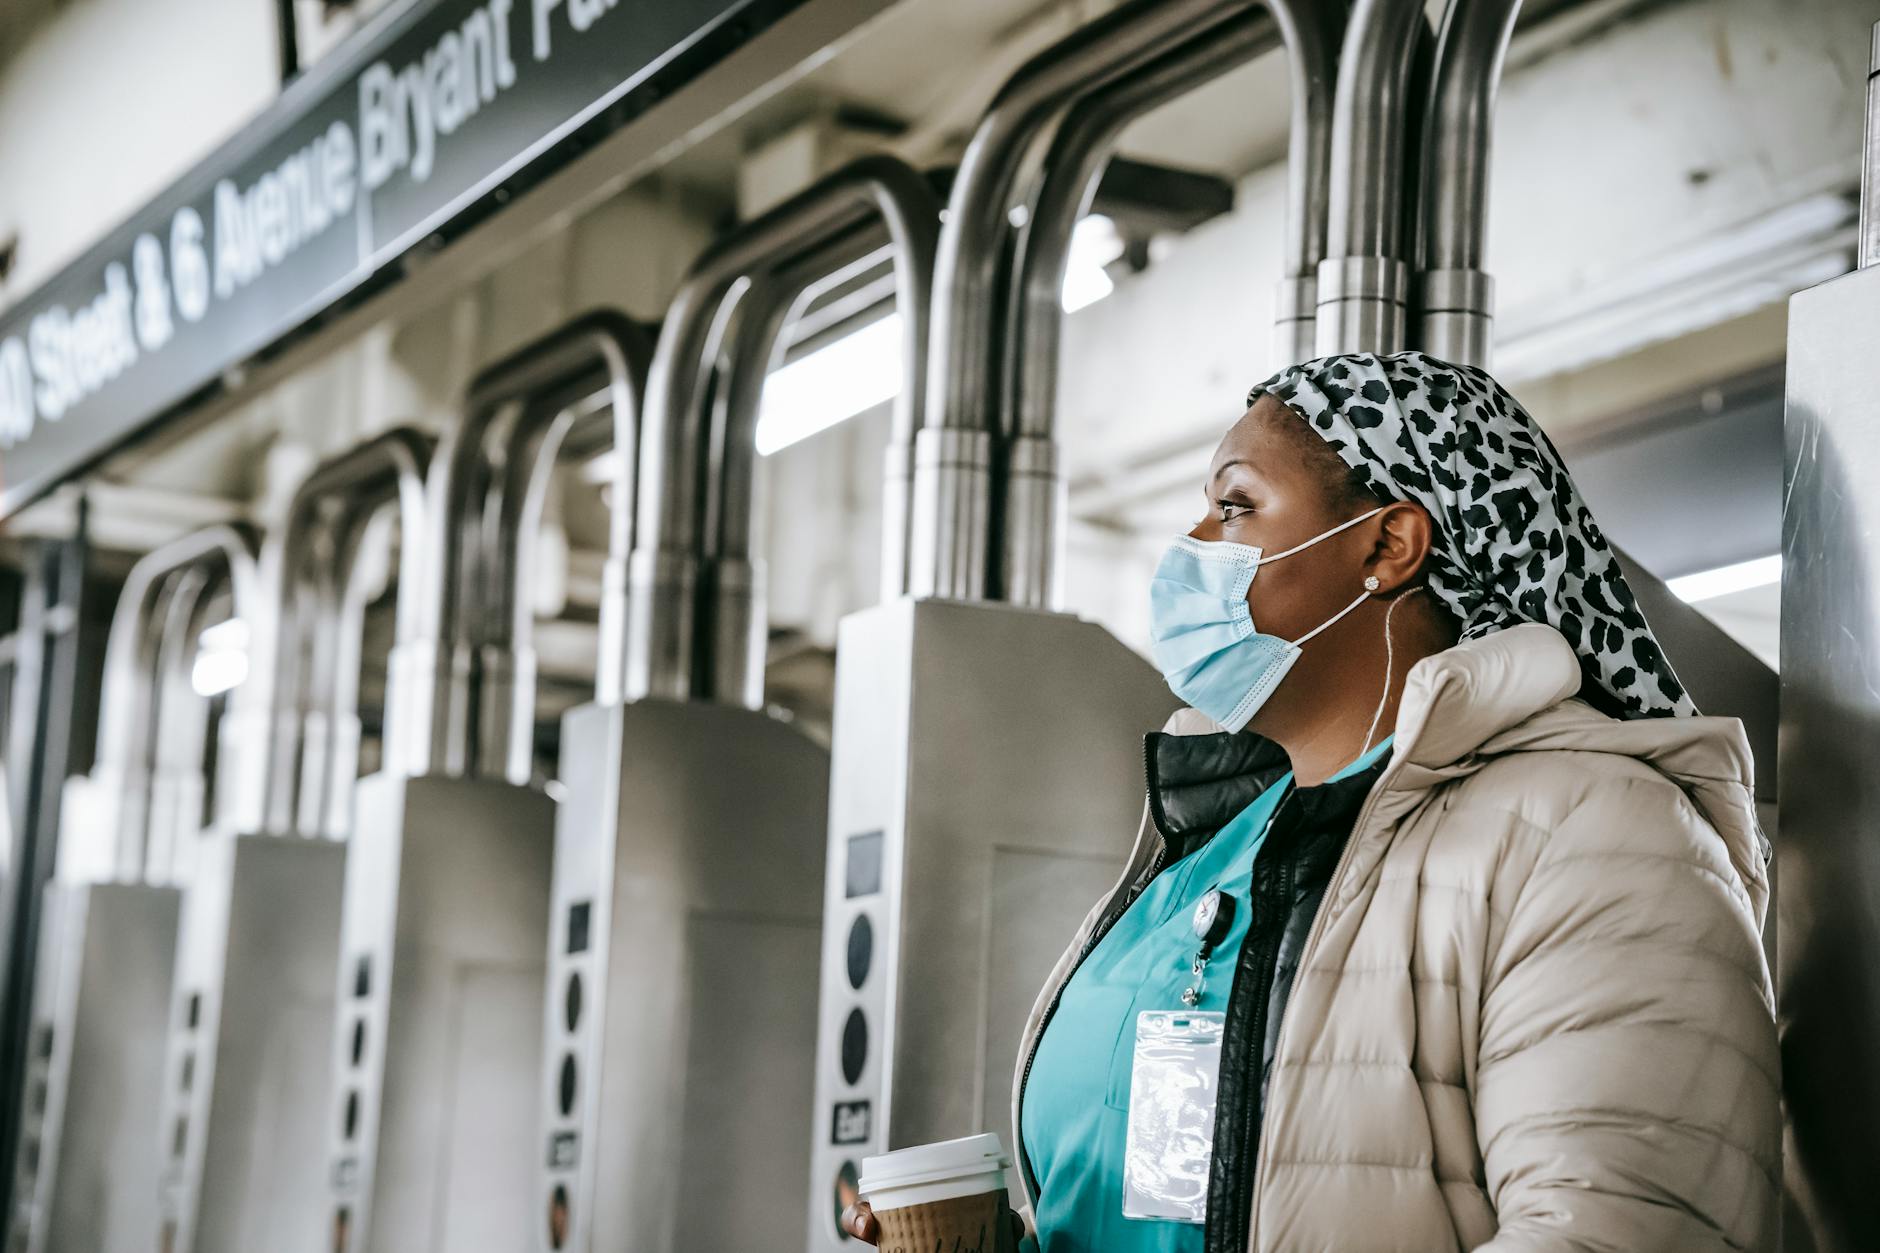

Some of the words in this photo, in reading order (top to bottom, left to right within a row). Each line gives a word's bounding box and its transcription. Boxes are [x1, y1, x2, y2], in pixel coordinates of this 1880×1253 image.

[28, 261, 139, 421] Street
[133, 231, 174, 351] &
[169, 205, 210, 323] 6
[213, 119, 356, 299] Avenue
[358, 0, 516, 190] Bryant
